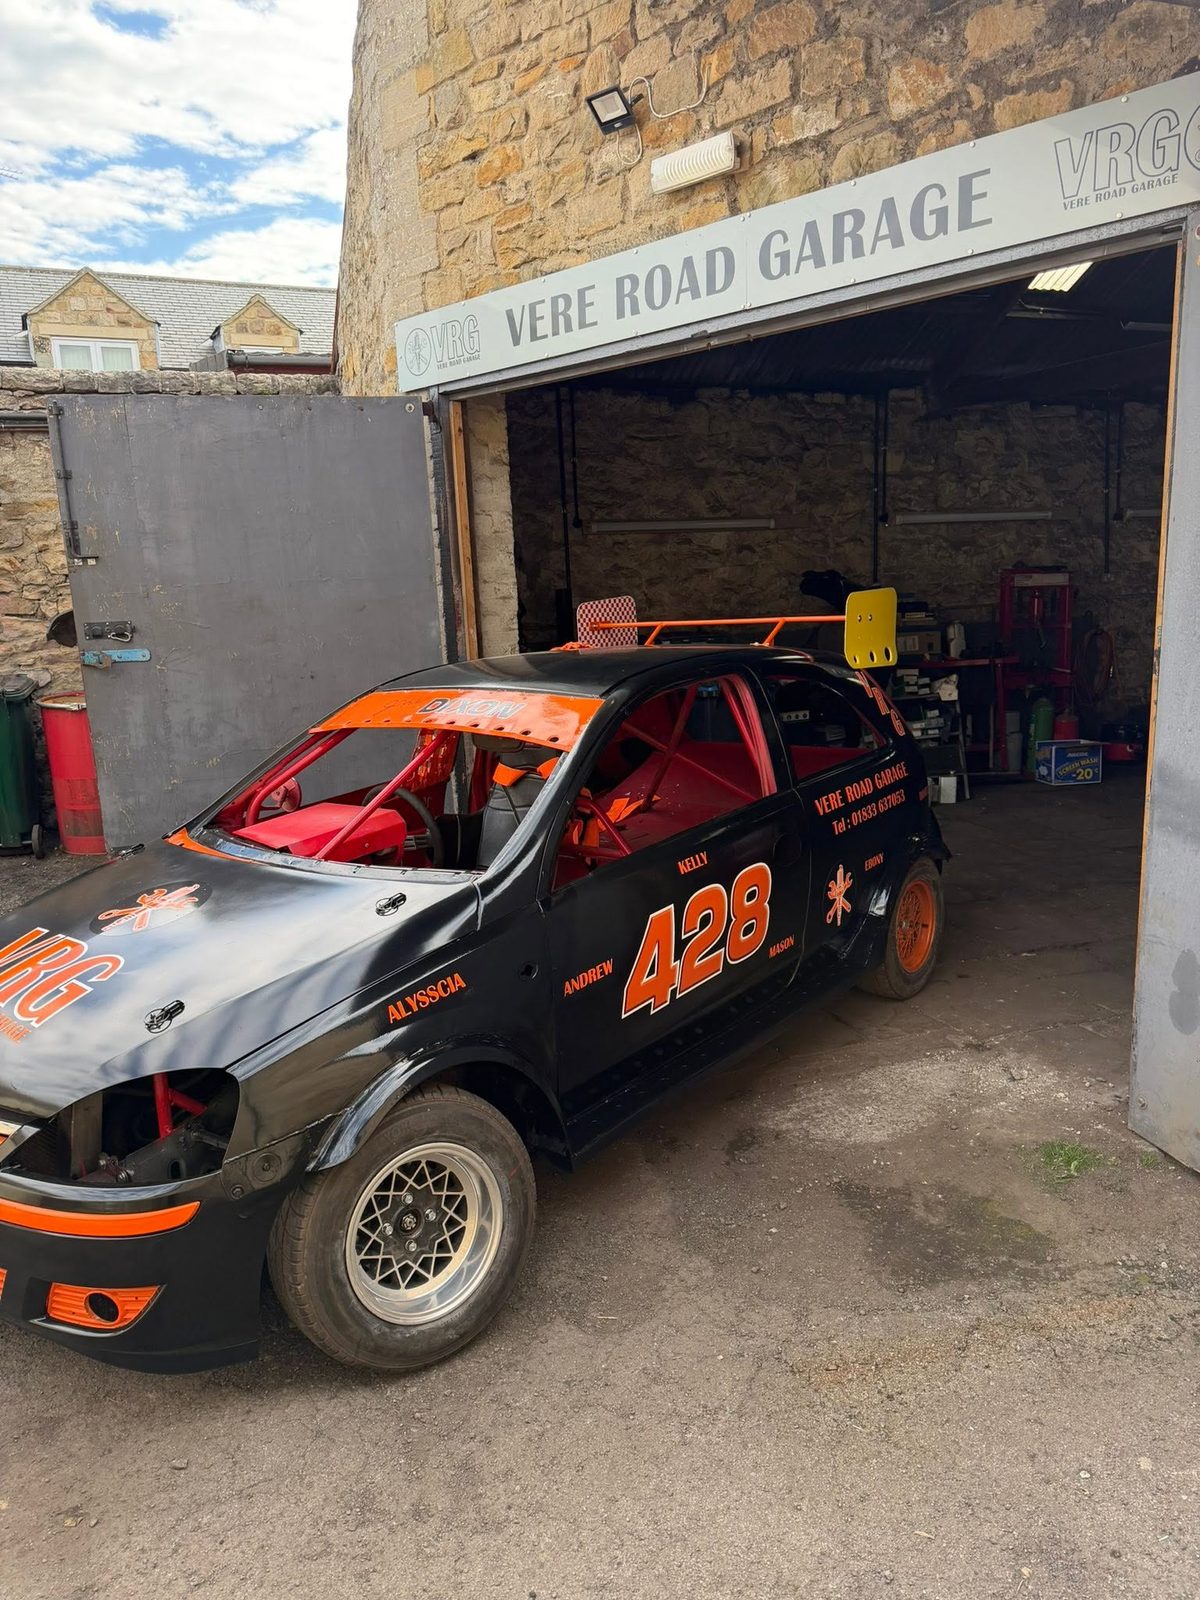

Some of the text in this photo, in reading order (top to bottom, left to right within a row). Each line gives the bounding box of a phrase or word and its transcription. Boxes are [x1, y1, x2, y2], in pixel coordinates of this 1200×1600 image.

[1054, 108, 1181, 200] VRG
[1063, 173, 1178, 210] VERE ROAD GARAGE
[504, 168, 993, 347] VERE ROAD GARAGE
[430, 315, 480, 363] VRG
[417, 698, 526, 720] DIXON
[814, 761, 909, 816] VERE ROAD GARAGE
[851, 803, 877, 826] 01833
[878, 789, 906, 813] 637053
[677, 851, 708, 875] KELLY
[864, 852, 884, 872] EBONY
[622, 862, 772, 1019] 428
[768, 934, 795, 959] MASON
[563, 958, 614, 997] ANDREW
[388, 973, 466, 1024] ALYSSCIA
